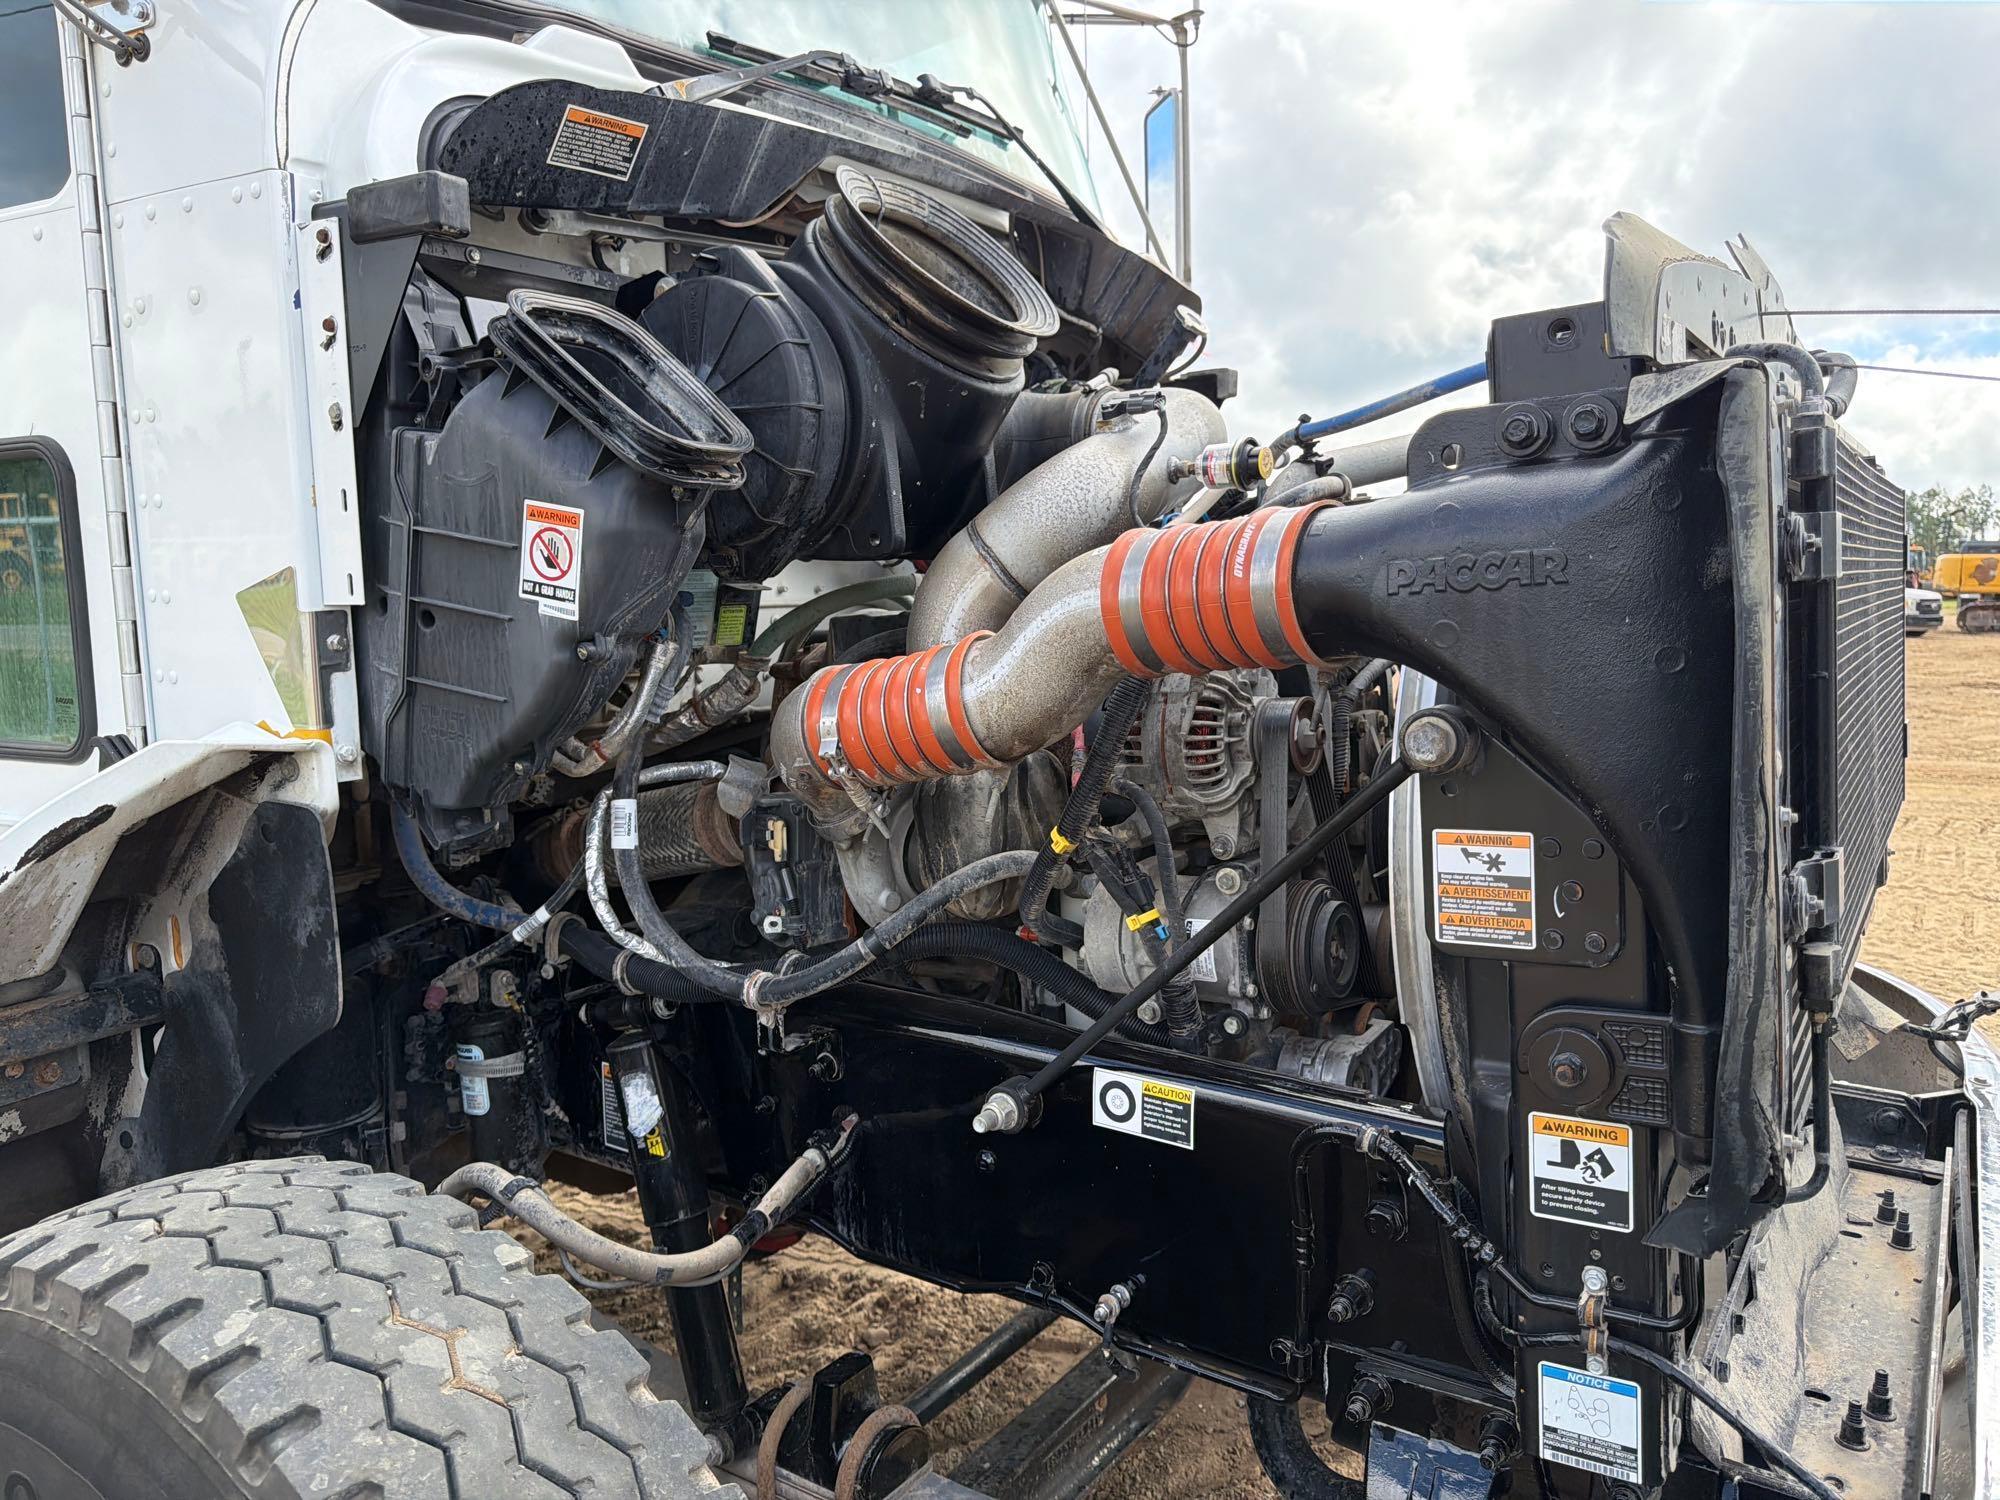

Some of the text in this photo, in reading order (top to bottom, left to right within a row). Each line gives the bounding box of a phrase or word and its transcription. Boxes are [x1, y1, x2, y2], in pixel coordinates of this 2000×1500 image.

[590, 116, 628, 132] WARNING
[536, 511, 576, 525] WARNING
[1234, 522, 1256, 578] DYNACRAFT
[1387, 548, 1568, 595] PACCAR
[523, 581, 575, 600] NOT A GRAB HANDLE
[1466, 836, 1512, 845] WARNING
[1453, 887, 1529, 900] AVERTISSEMENT
[1459, 916, 1525, 929] ADVERTENCIA
[1151, 1086, 1191, 1101] CAUTION
[1553, 1122, 1618, 1140] WARNING
[1558, 1186, 1576, 1195] tilting
[1577, 1188, 1593, 1197] hood
[1549, 1201, 1573, 1210] prevent
[1574, 1204, 1599, 1215] closing.
[1564, 1194, 1583, 1204] safety
[1584, 1198, 1606, 1208] device
[1567, 1372, 1610, 1390] NOTICE
[1557, 1429, 1579, 1438] ENGINE
[1595, 1438, 1621, 1450] ROUTING
[1544, 1439, 1568, 1450] PARCOURS
[1583, 1450, 1607, 1460] COURROIE
[1616, 1458, 1638, 1468] MOTEUR
[1587, 1443, 1606, 1452] BANDA
[1615, 1451, 1636, 1460] MOTOR
